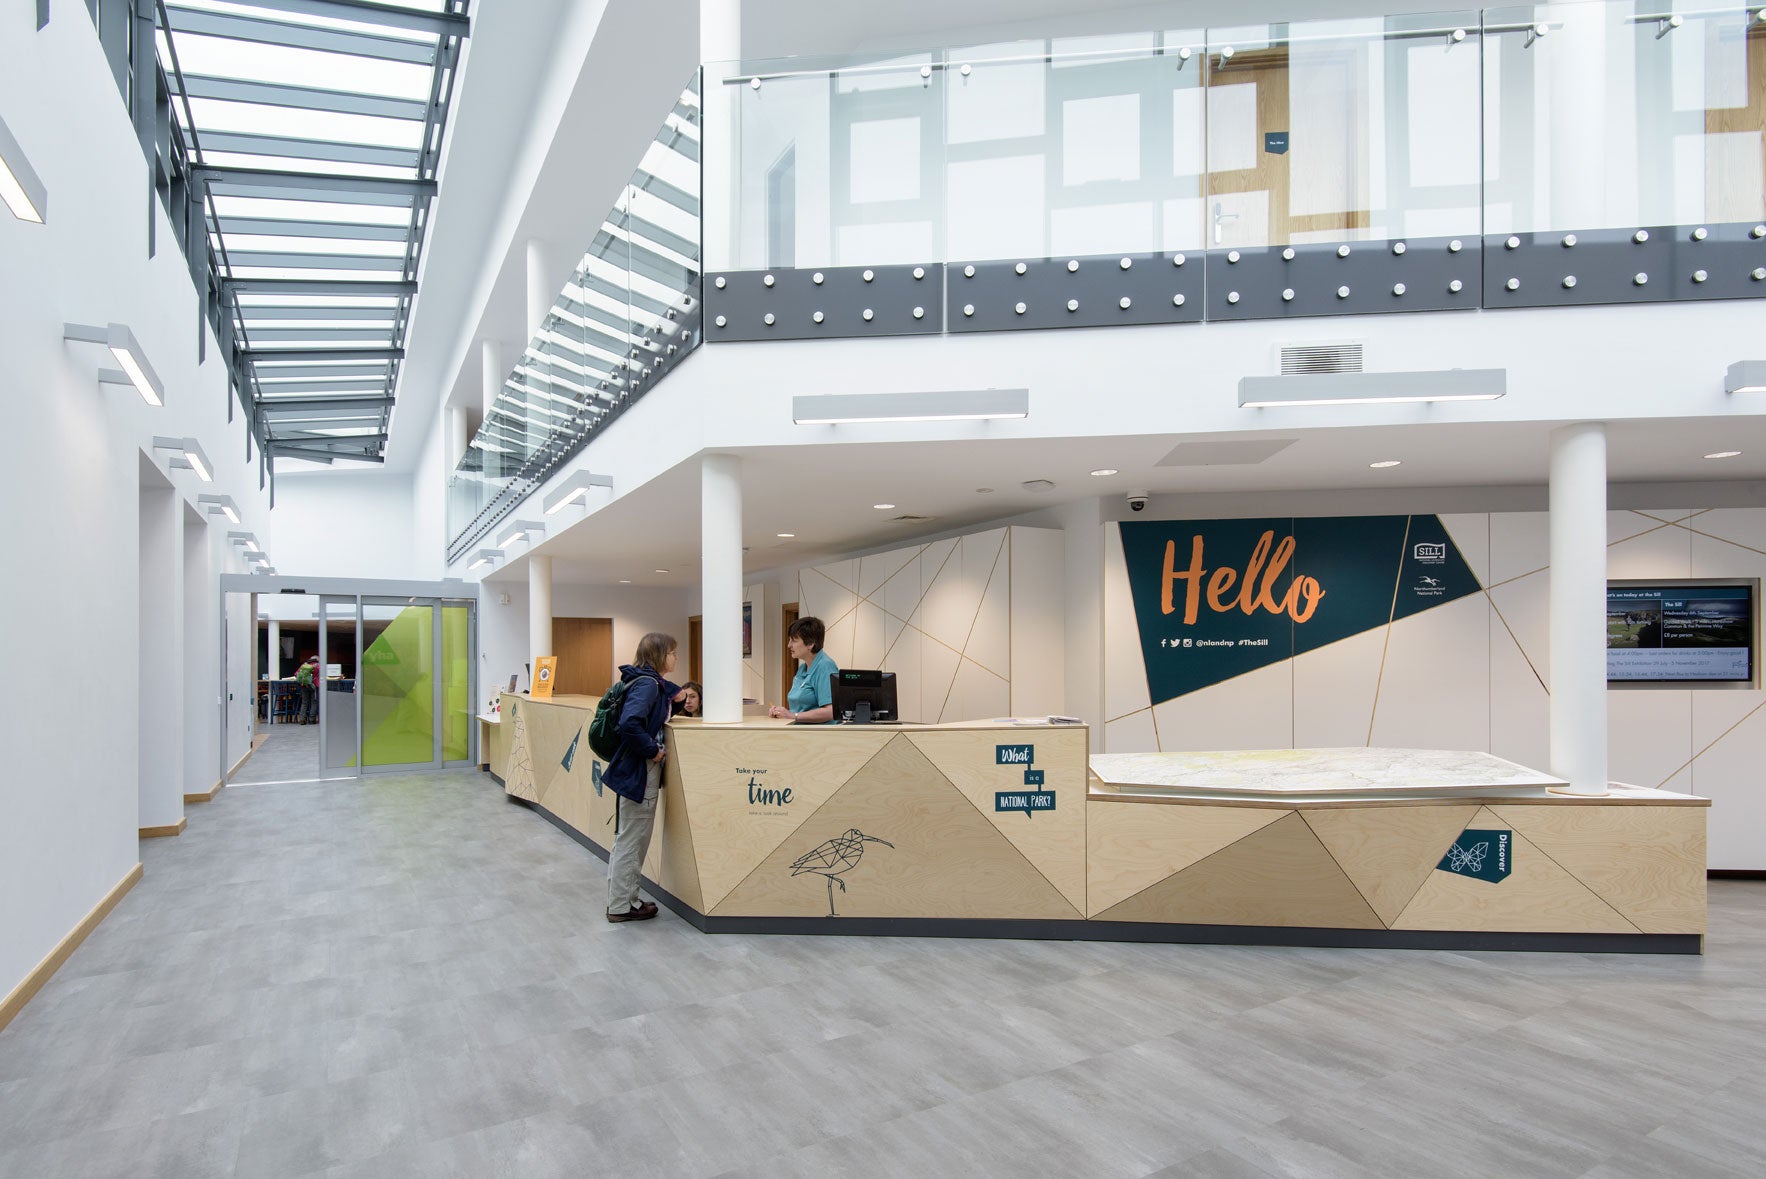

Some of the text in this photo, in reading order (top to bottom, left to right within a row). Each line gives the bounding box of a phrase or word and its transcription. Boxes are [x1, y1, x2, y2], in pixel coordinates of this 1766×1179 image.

[1418, 547, 1441, 555] SILL
[1161, 530, 1326, 625] Hello
[1196, 638, 1268, 647] @nlandnp #TheSill
[1001, 747, 1030, 762] What
[747, 777, 795, 807] time
[1000, 795, 1051, 808] NATIONAL PARK?
[1499, 834, 1507, 871] Discover
